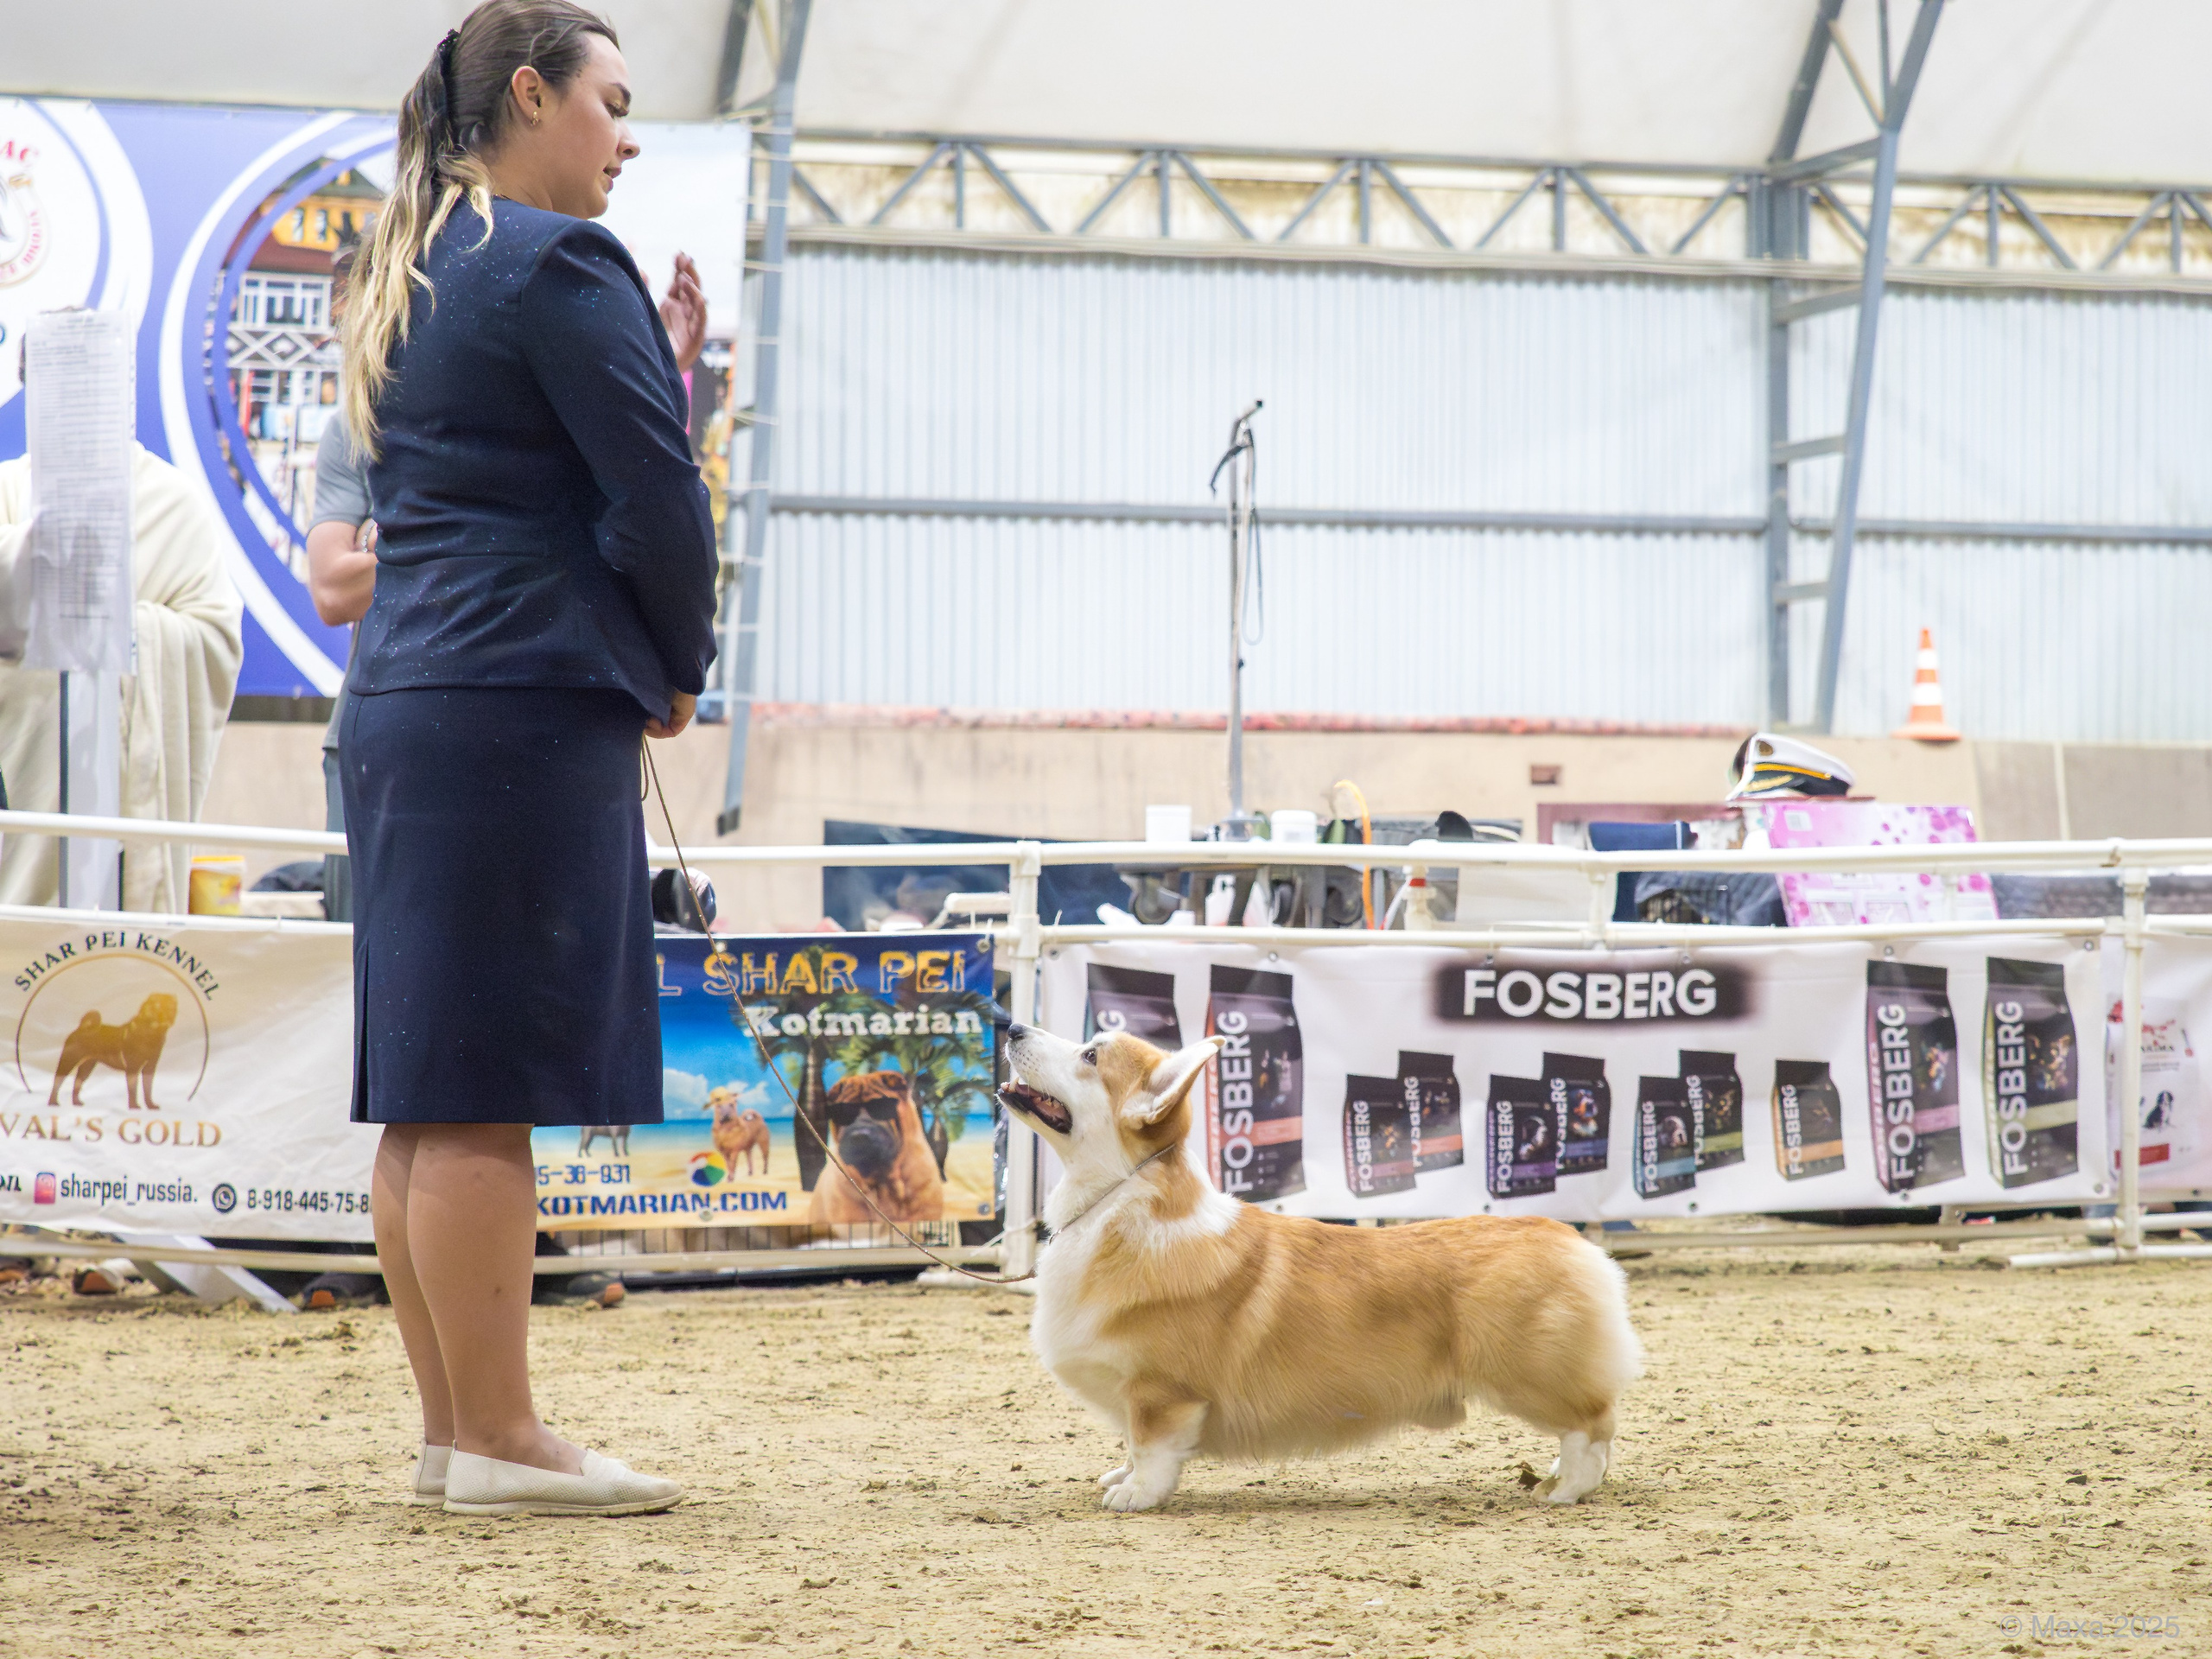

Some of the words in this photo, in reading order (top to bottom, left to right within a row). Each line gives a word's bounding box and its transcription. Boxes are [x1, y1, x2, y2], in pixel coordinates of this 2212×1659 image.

[15, 942, 77, 992] SHAR
[86, 931, 126, 952] PEI
[136, 932, 219, 1001] KENNEL
[702, 951, 860, 996] SHAR
[880, 950, 966, 994] PEI
[743, 1003, 982, 1037] Kotmarian
[1463, 969, 1717, 1020] FOSBERG
[1217, 1010, 1254, 1192] FOSBERG
[1877, 1003, 1915, 1179] FOSBERG
[1995, 1001, 2029, 1176] FOSBERG
[118, 1118, 222, 1147] GOLD
[247, 1188, 370, 1214] 8-918-445-75-8
